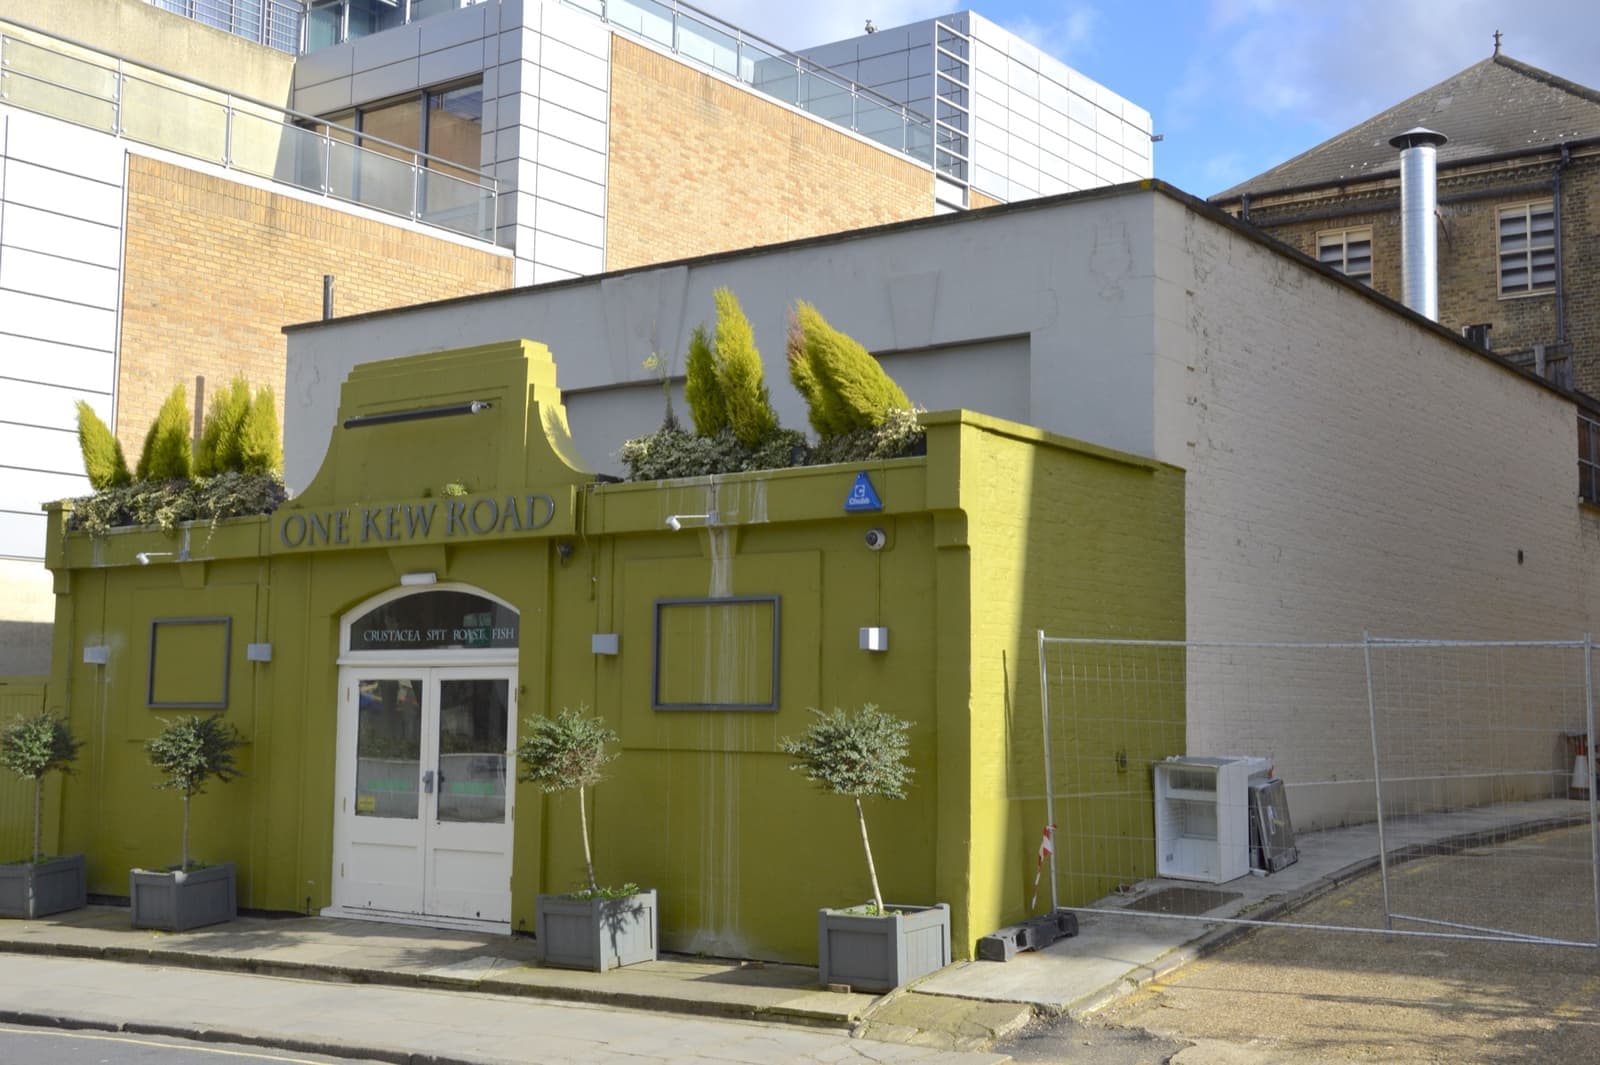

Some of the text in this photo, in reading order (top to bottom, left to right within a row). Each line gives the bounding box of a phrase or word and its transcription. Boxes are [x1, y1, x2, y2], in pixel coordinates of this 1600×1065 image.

[281, 494, 555, 548] ONE KEW ROAD
[363, 627, 514, 642] CRUSTACEA SPIT ROAST FISH
